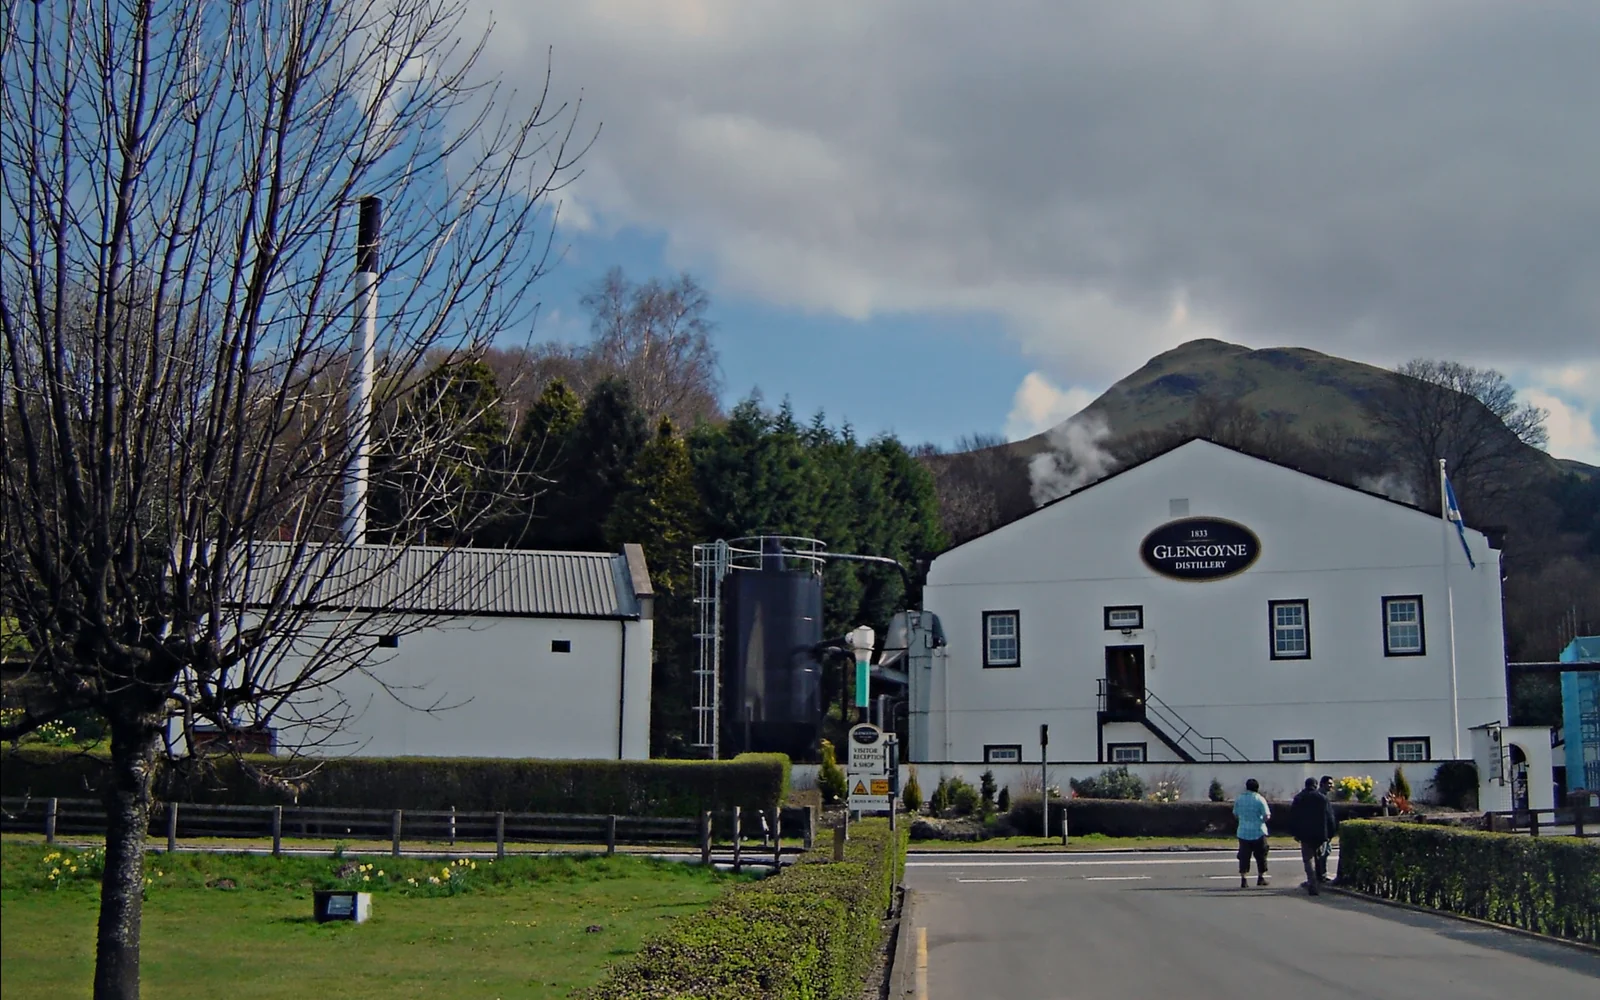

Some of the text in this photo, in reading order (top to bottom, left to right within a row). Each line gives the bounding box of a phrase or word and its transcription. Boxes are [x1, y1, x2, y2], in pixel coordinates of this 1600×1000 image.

[1191, 530, 1208, 538] 1833
[1153, 544, 1247, 559] GLENGOYNE
[1175, 561, 1227, 570] DISTILLERY
